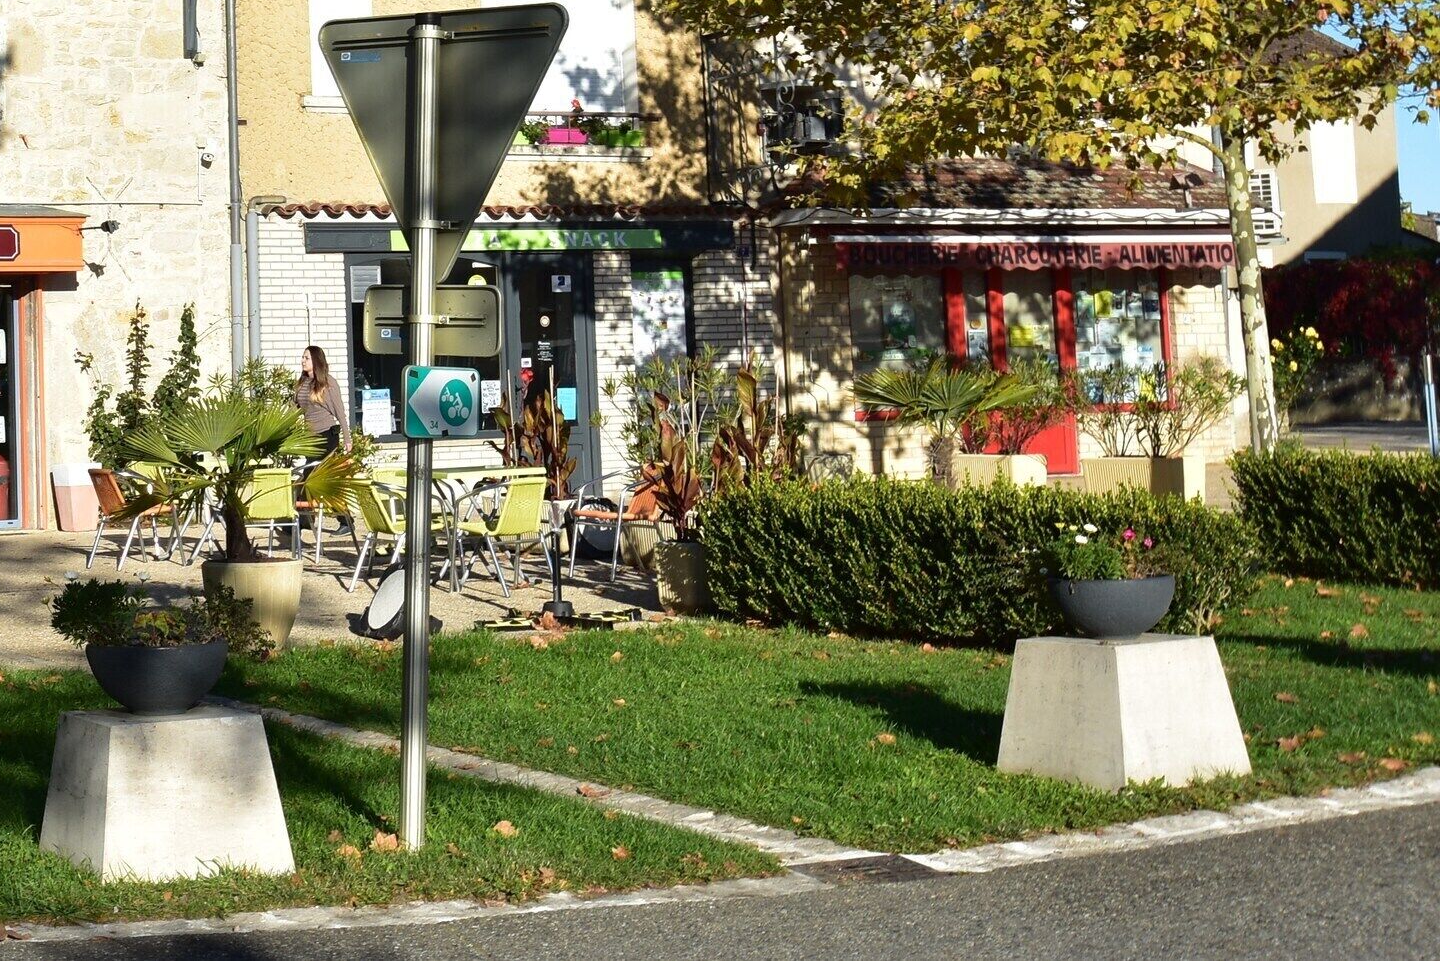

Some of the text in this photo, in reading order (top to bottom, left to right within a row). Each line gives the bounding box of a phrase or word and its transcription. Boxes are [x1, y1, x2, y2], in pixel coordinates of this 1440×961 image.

[548, 230, 628, 247] SNACK
[849, 243, 1234, 265] BOUCHERIE CHARCUTERIE ALIMENTATIO
[429, 419, 439, 429] 34
